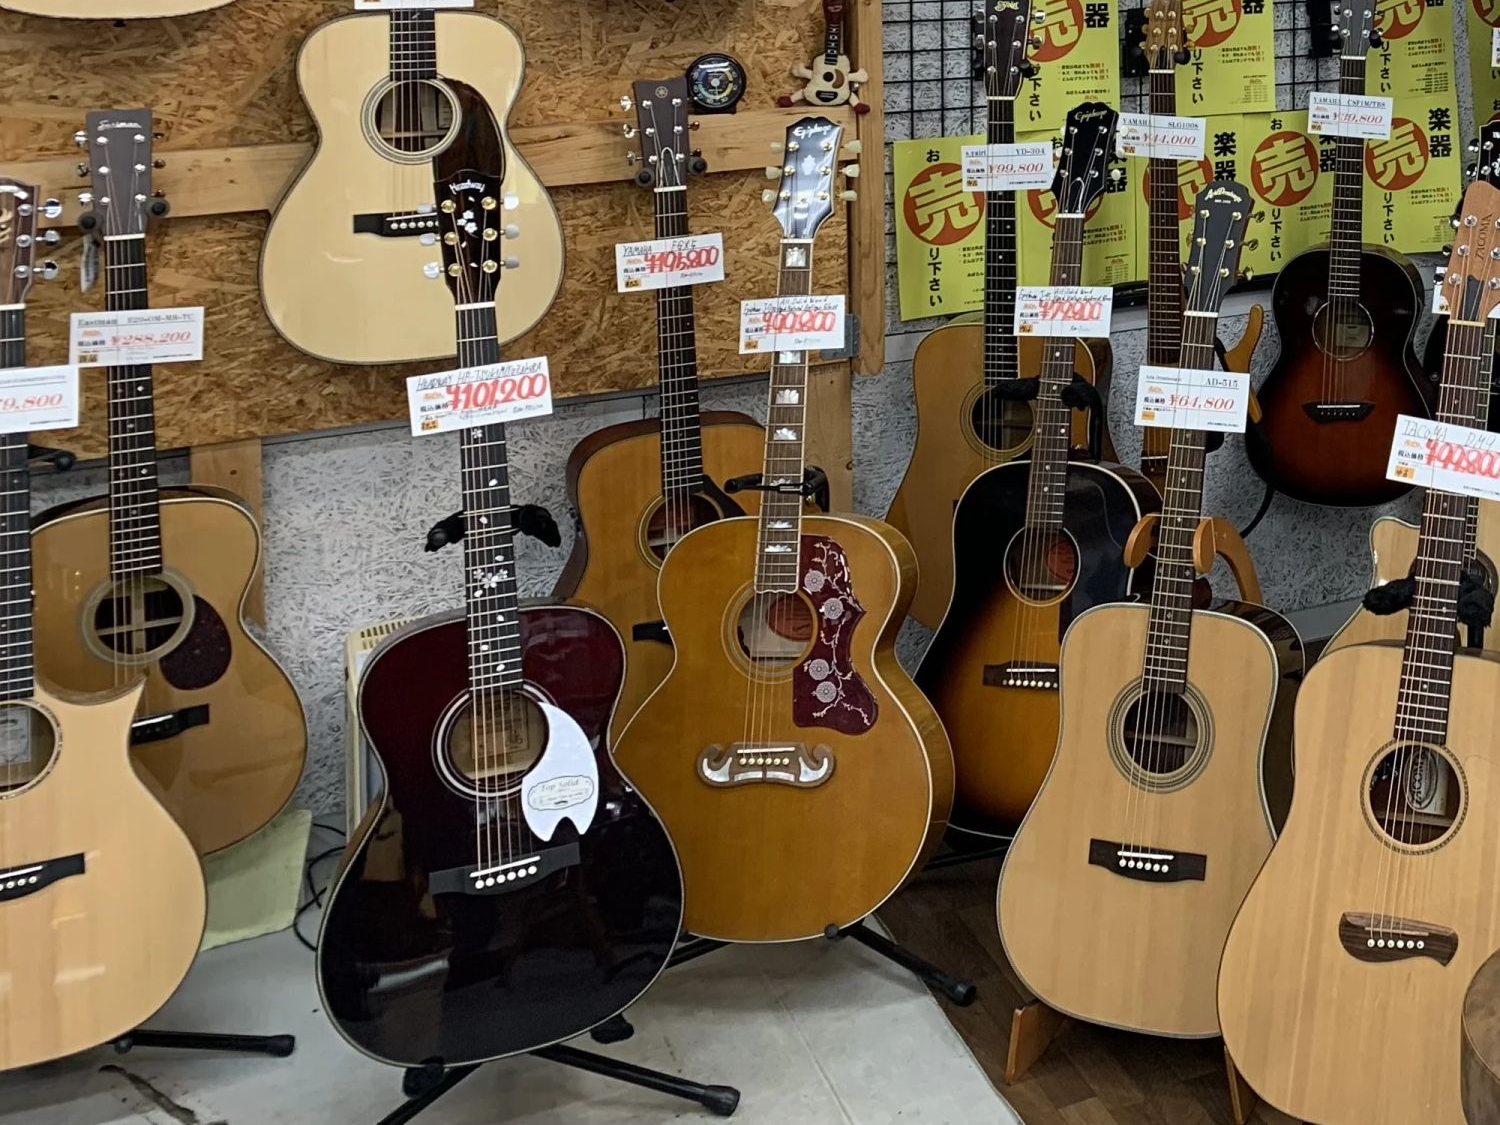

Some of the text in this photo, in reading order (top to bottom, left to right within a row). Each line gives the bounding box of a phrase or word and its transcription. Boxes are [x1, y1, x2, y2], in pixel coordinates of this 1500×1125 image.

[1428, 107, 1452, 158] 楽器
[449, 178, 486, 194] Headway
[1474, 213, 1493, 260] TACOMA
[1205, 377, 1239, 388] AD-515
[0, 393, 63, 412] 9,800
[1397, 449, 1425, 463] 税込価格
